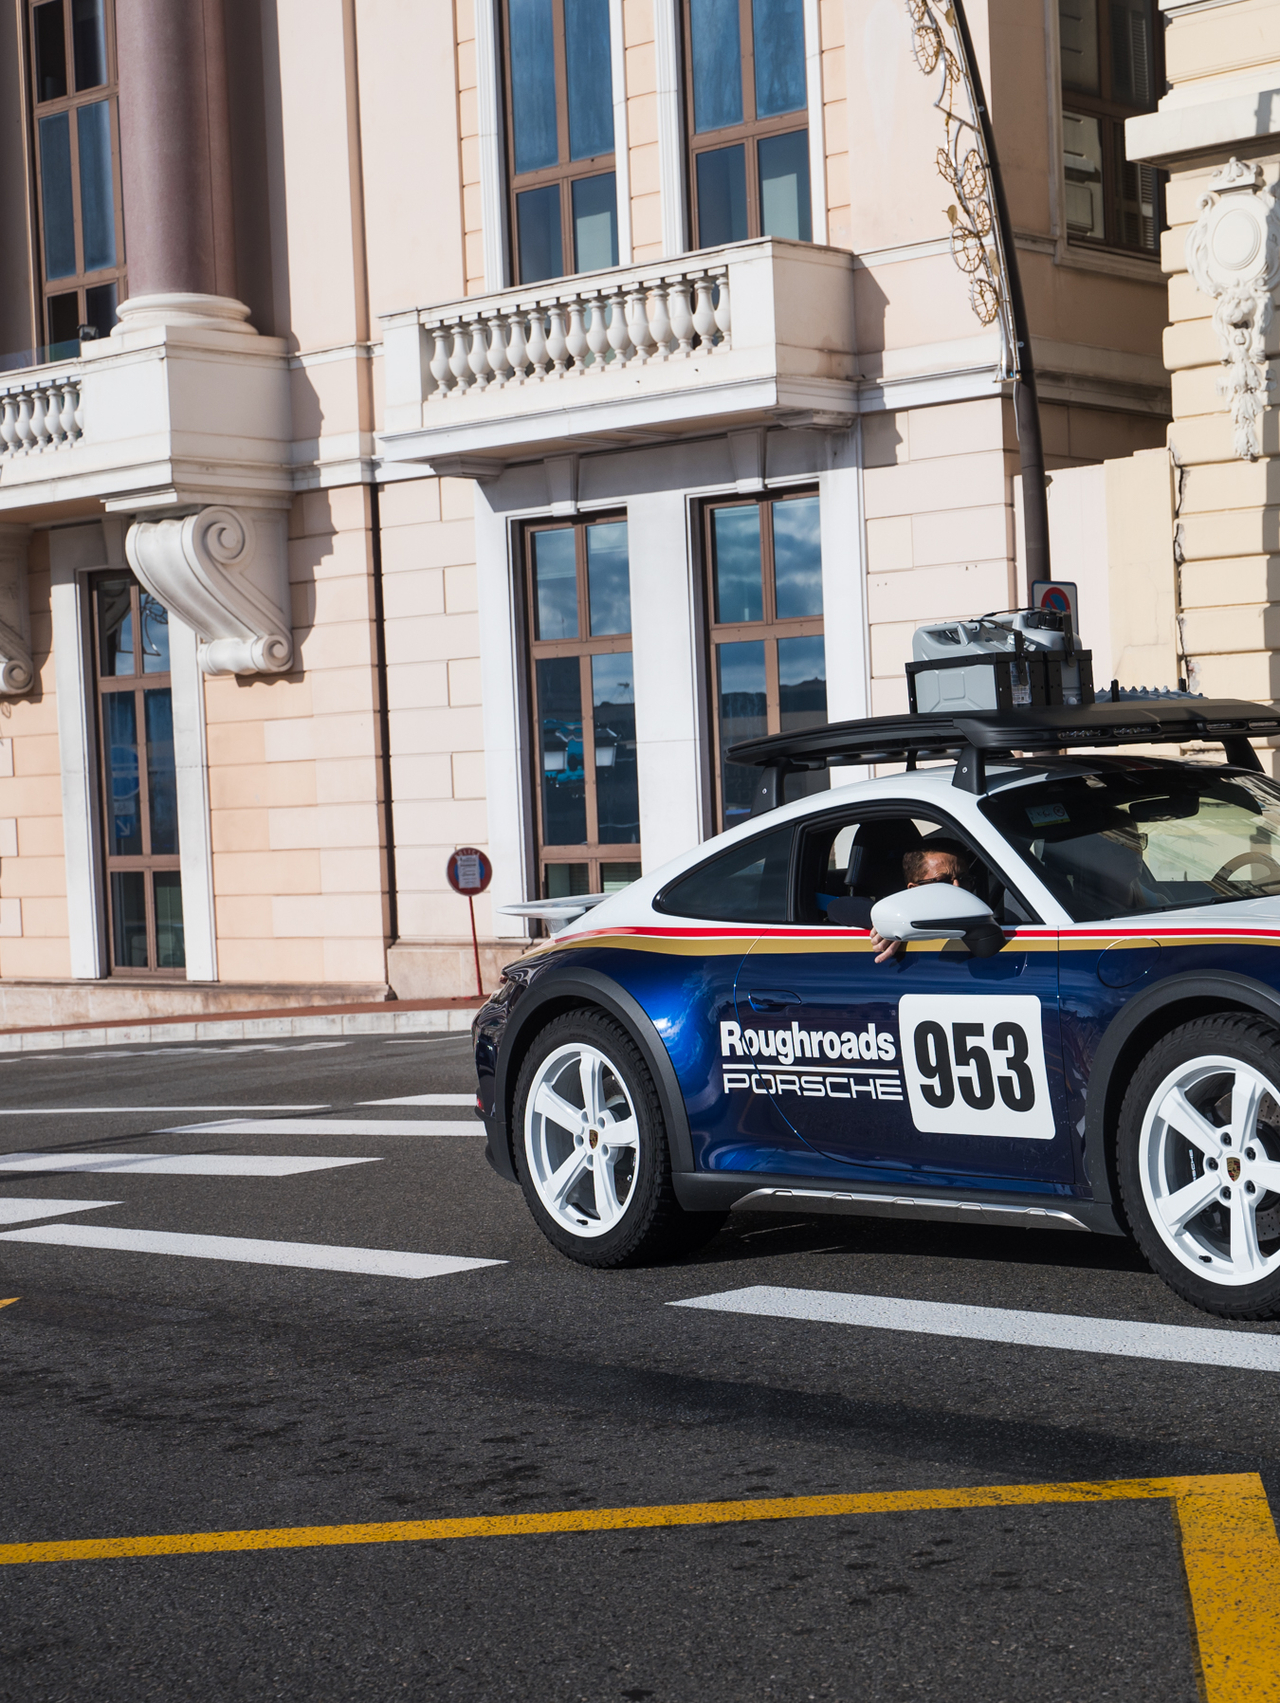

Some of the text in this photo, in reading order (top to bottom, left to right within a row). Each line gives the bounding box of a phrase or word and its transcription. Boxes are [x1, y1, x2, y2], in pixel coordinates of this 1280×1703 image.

[720, 1021, 896, 1064] Roughroads
[723, 1073, 904, 1100] PORSCHE
[914, 1020, 1036, 1112] 953
